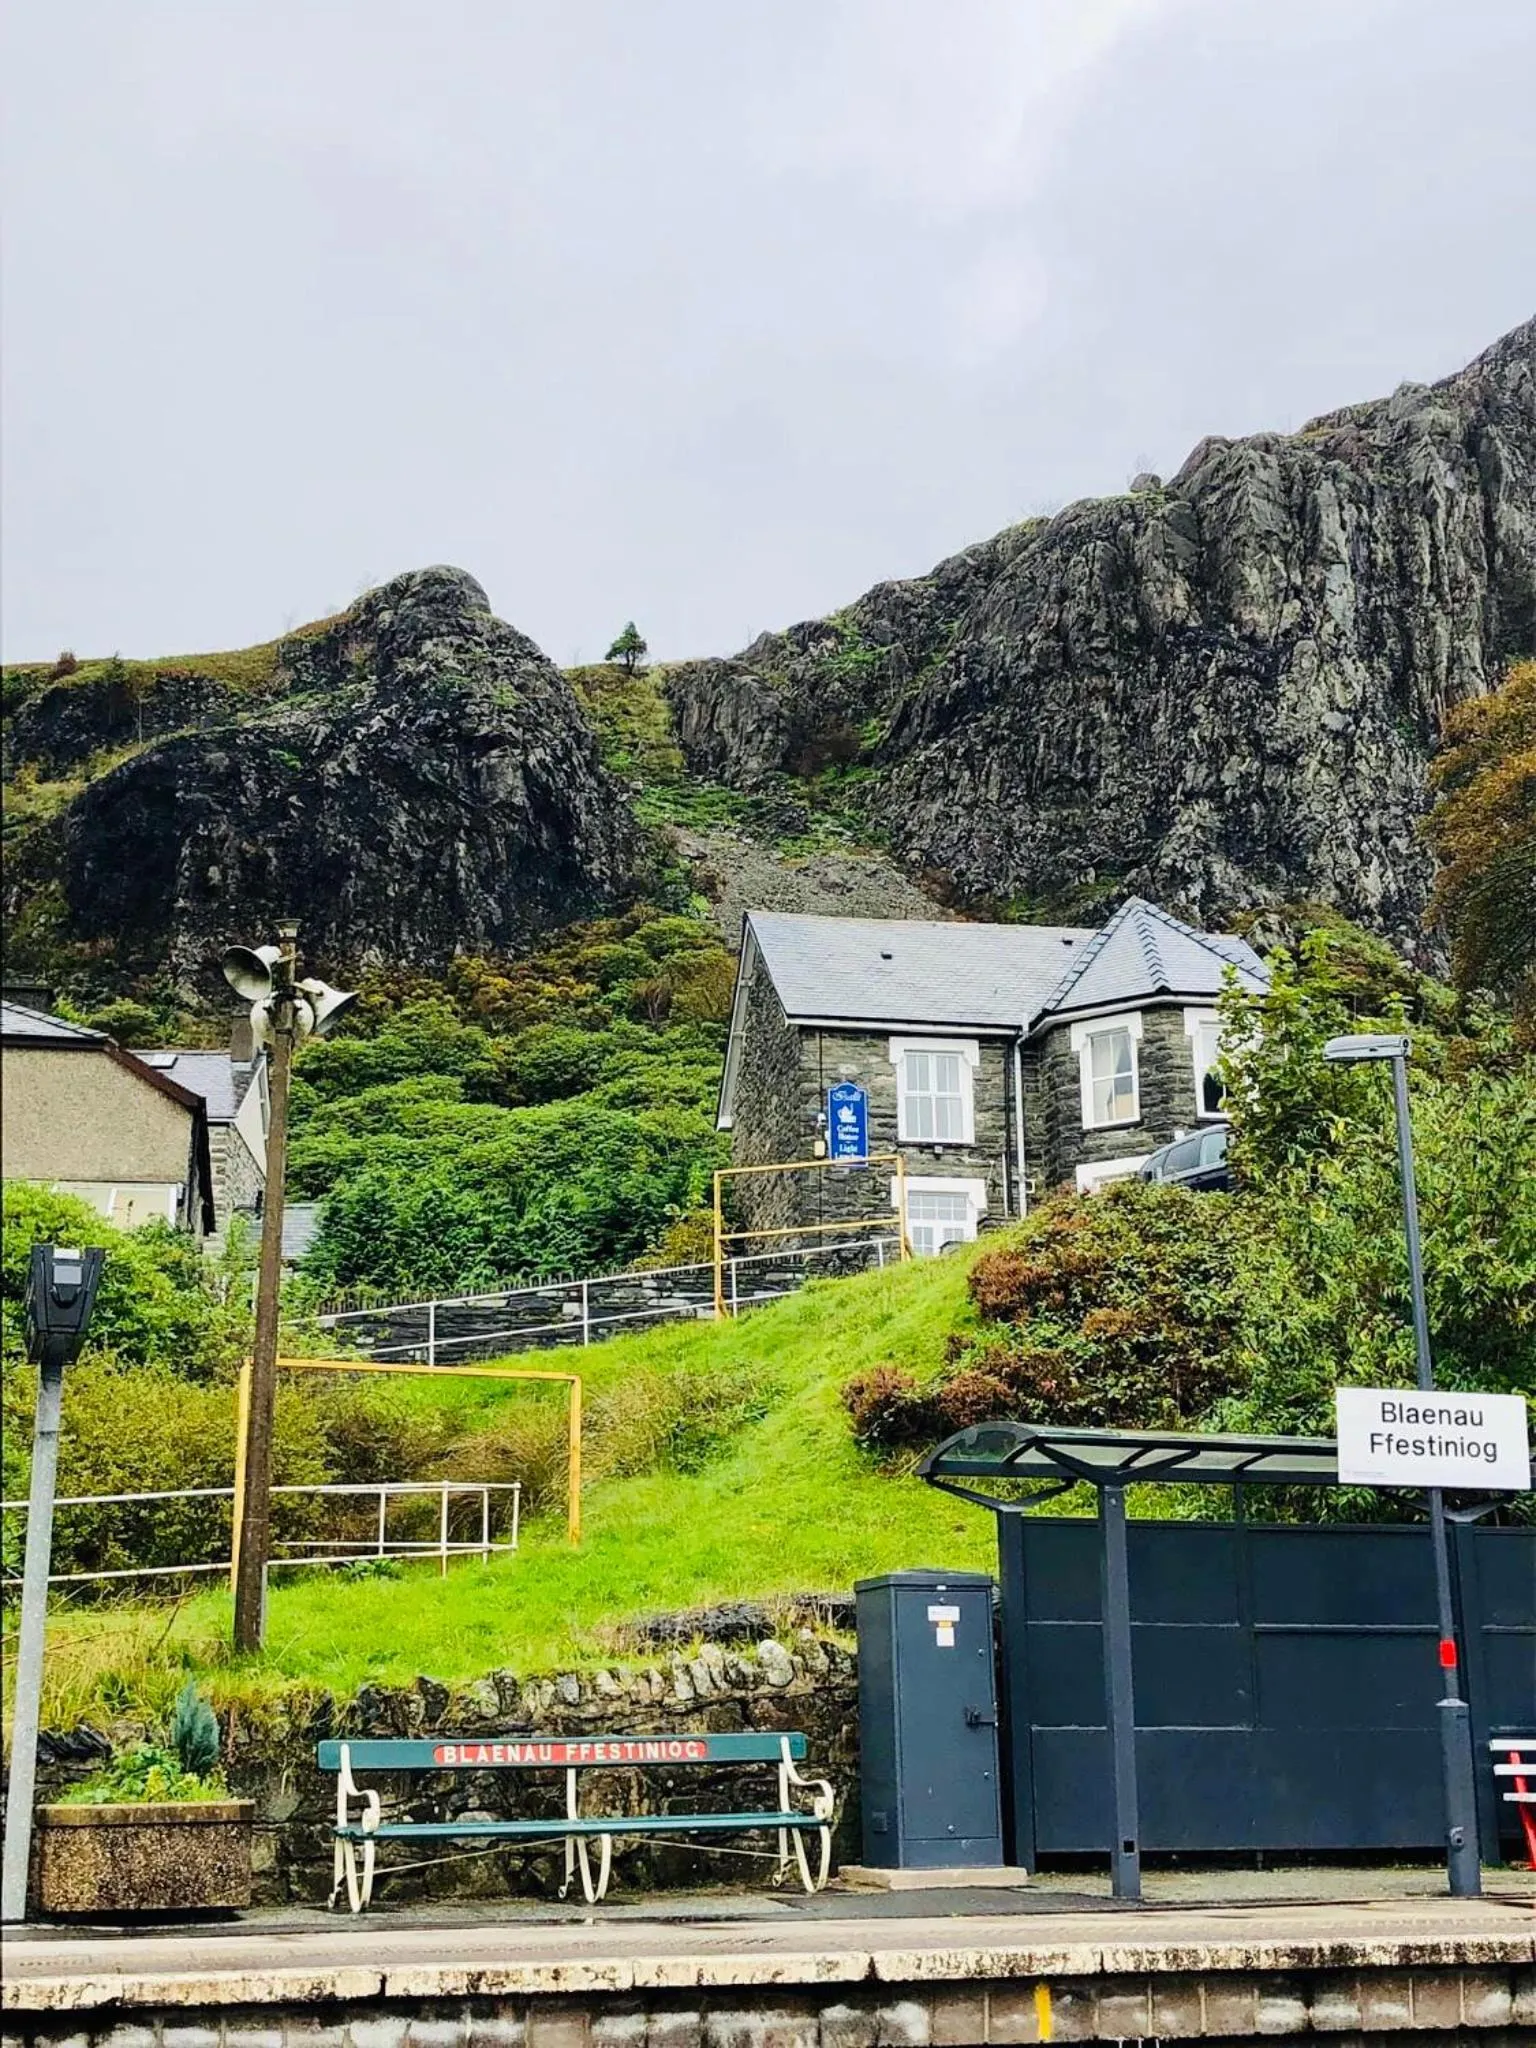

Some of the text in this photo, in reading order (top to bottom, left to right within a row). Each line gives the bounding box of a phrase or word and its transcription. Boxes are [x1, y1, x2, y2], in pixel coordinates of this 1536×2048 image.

[1381, 1401, 1484, 1427] Blaenau
[1370, 1432, 1498, 1463] Ffestiniog
[443, 1741, 700, 1764] BLAENAU FFESTINIOG
